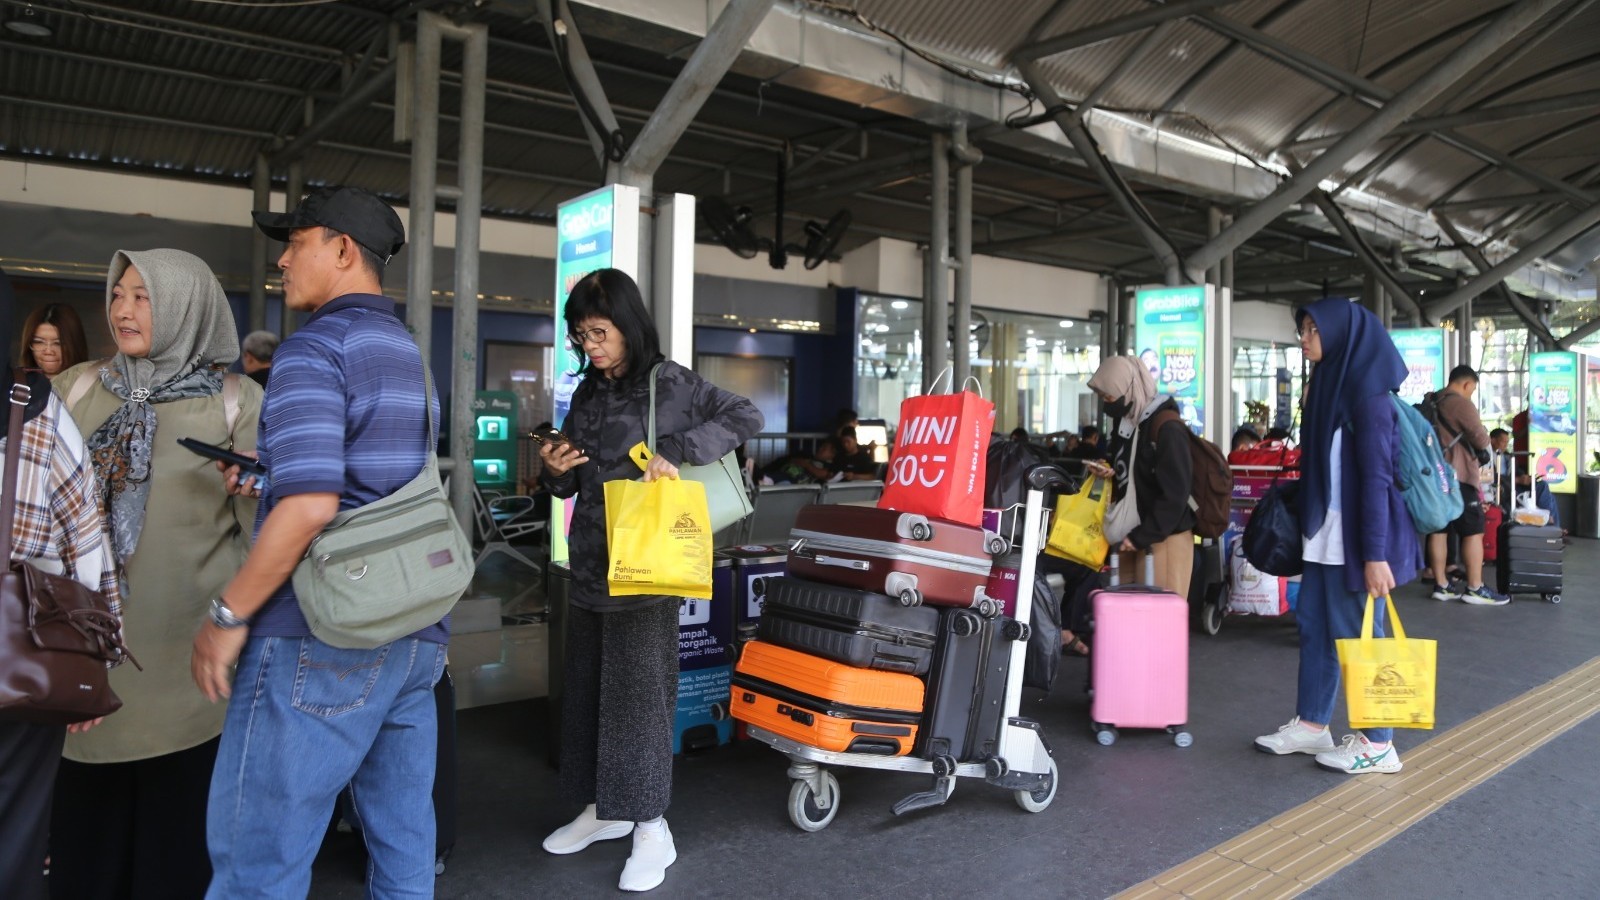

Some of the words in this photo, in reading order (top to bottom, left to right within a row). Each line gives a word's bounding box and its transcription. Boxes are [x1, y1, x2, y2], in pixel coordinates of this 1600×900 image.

[561, 203, 613, 237] GrabCar
[1143, 294, 1200, 311] GrabBike
[1160, 313, 1182, 322] Hemat
[1166, 355, 1194, 369] NON
[1162, 367, 1196, 382] STOP
[900, 415, 958, 448] MINI
[970, 451, 979, 472] FOR
[1536, 447, 1568, 484] 6
[613, 573, 633, 581] Bumi
[614, 566, 652, 575] Pahlawan
[1004, 572, 1017, 581] KAI
[678, 628, 708, 640] ampah
[678, 636, 718, 649] norganik
[678, 649, 703, 660] organic
[704, 647, 724, 655] Waste
[695, 673, 711, 682] botol
[677, 690, 702, 698] emasan
[1364, 688, 1416, 696] PAHLAWAN
